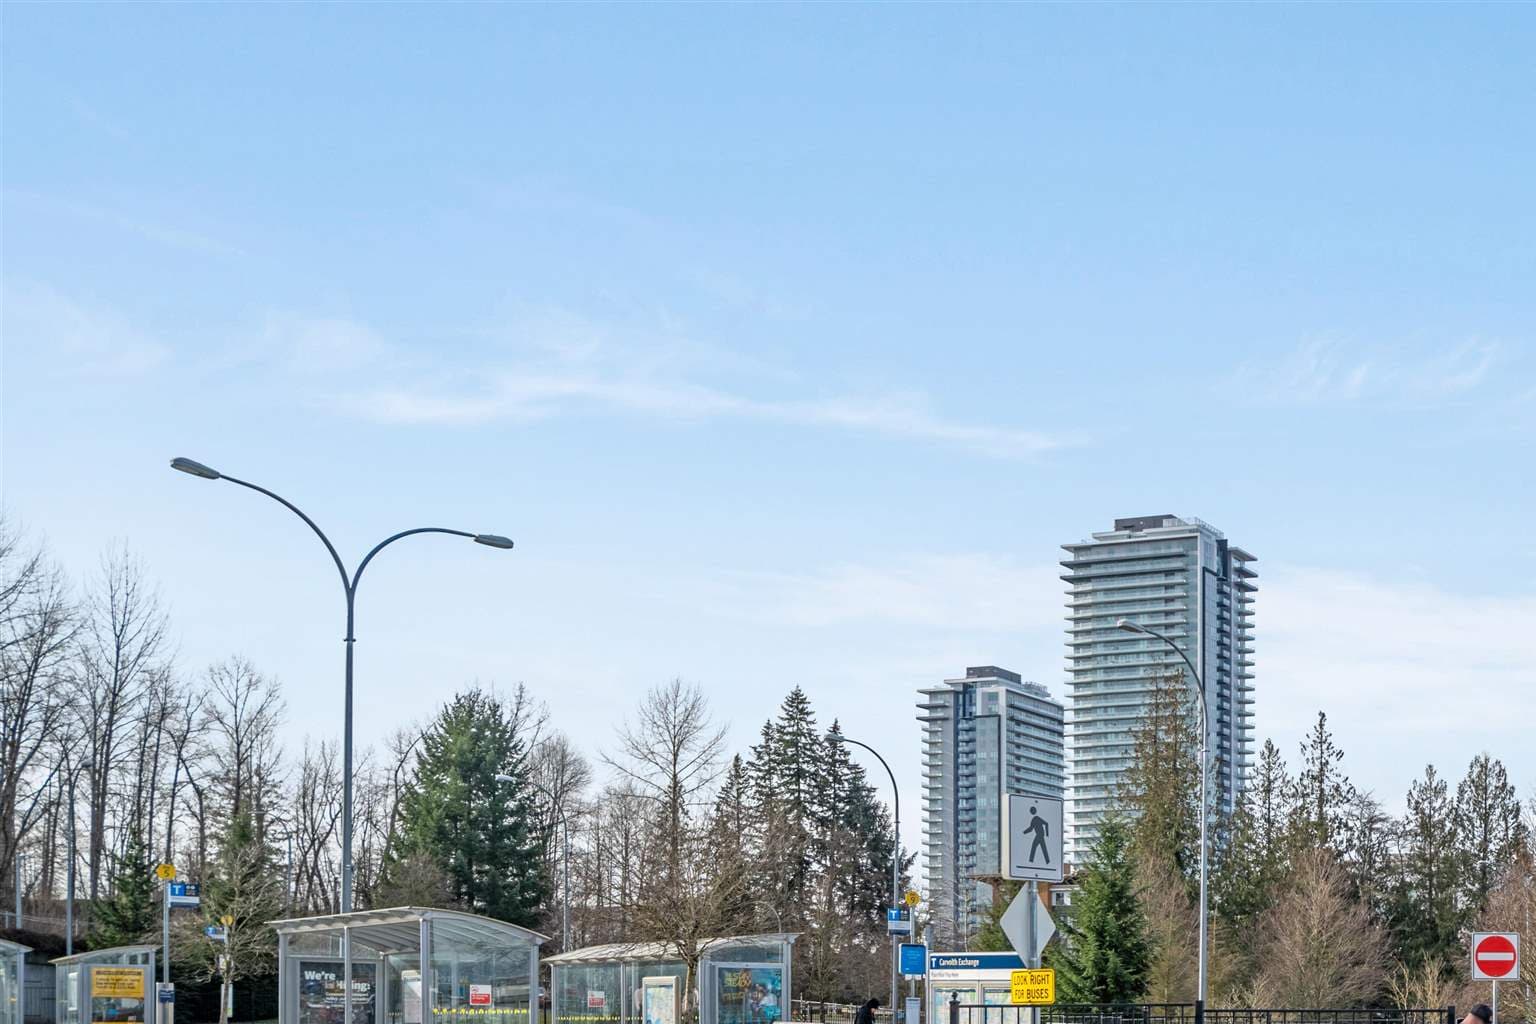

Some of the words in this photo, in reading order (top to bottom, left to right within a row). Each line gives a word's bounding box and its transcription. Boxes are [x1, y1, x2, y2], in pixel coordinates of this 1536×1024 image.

[172, 885, 181, 895] T
[890, 910, 897, 919] T
[304, 970, 336, 980] We're
[1014, 975, 1028, 985] LOOK
[1030, 974, 1050, 985] RIGHT
[336, 980, 371, 992] Hing:
[1015, 989, 1025, 999] FOR
[1026, 988, 1049, 999] BUSES
